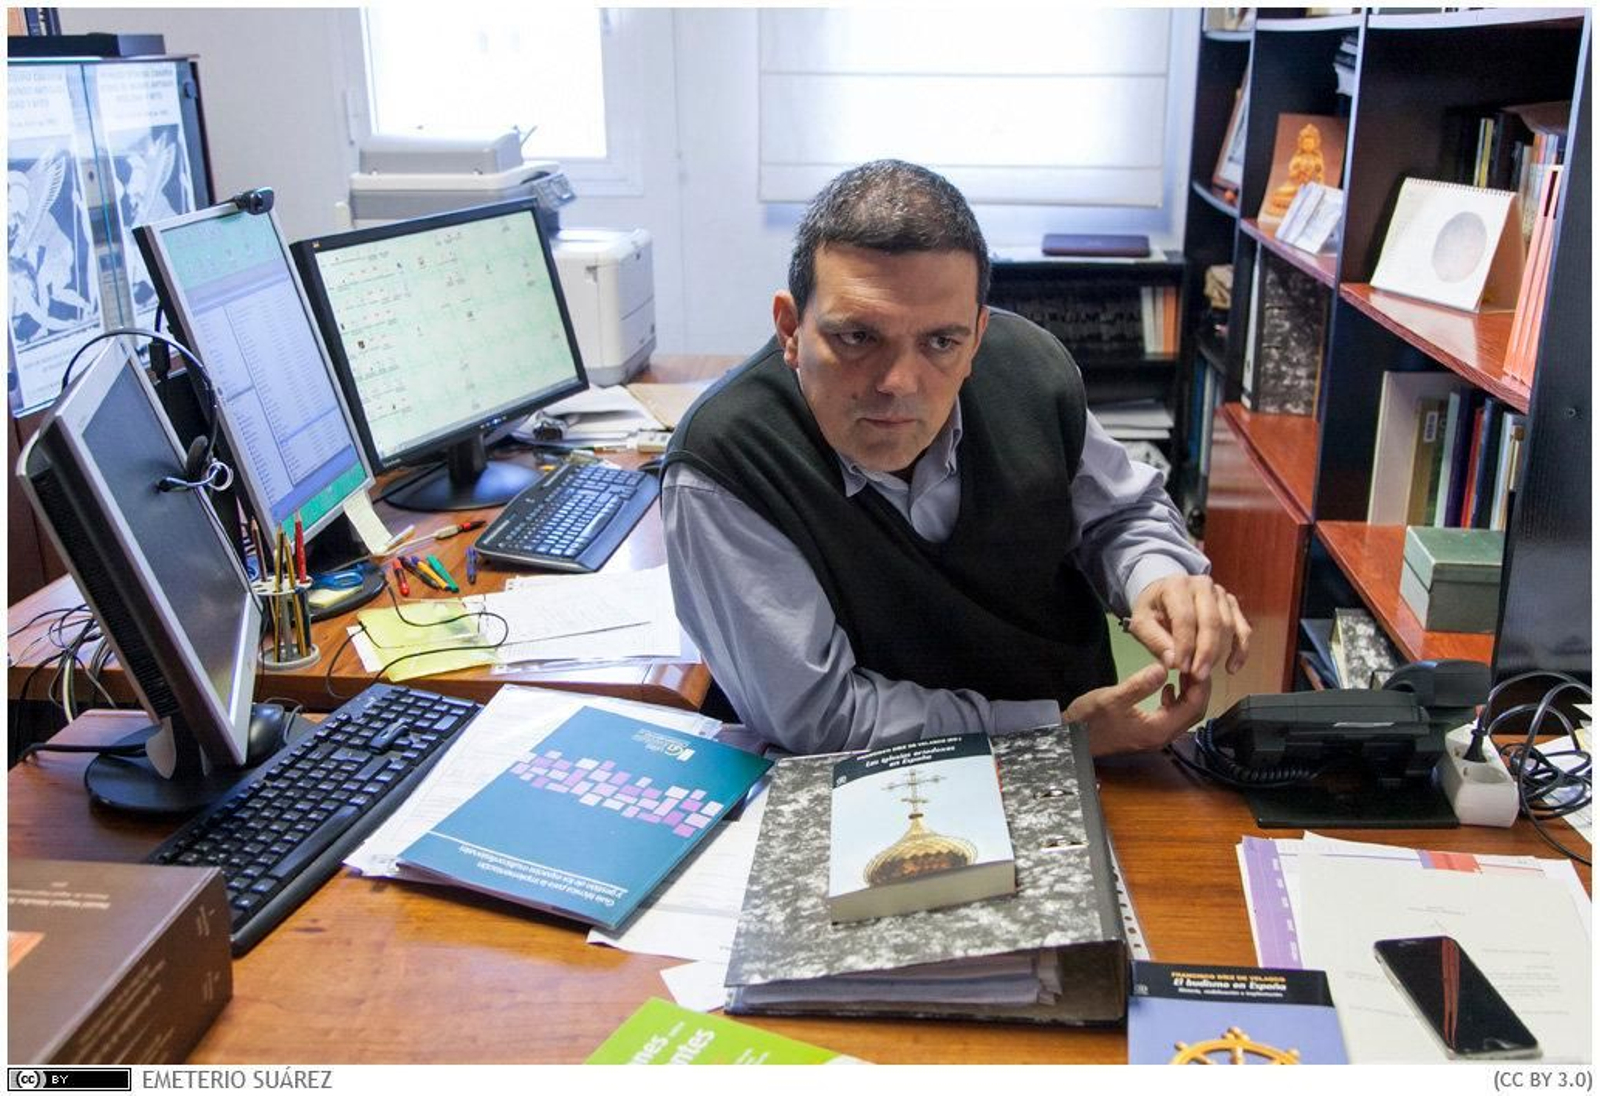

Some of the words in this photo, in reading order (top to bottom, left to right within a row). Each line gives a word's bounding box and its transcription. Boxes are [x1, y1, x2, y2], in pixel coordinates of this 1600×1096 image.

[1173, 977, 1184, 986] El
[1186, 978, 1230, 988] budismo
[1249, 981, 1287, 991] España
